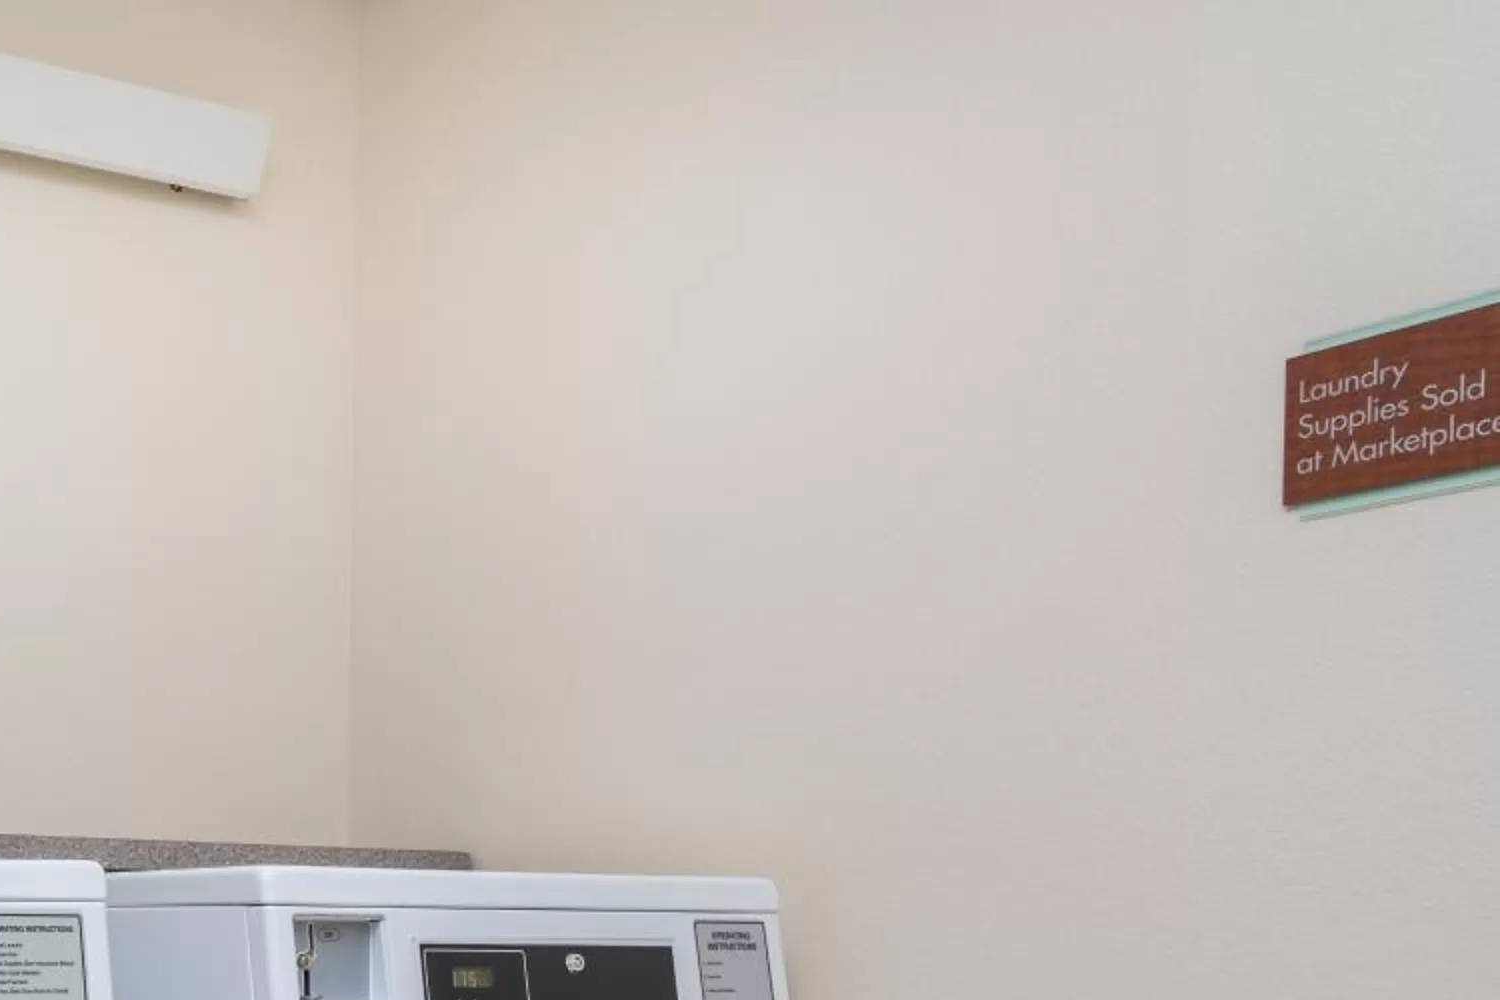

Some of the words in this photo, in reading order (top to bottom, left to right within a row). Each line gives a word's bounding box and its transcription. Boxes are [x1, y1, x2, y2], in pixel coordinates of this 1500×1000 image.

[1297, 395, 1410, 440] Supplies
[1420, 367, 1487, 411] Sold
[1299, 356, 1410, 404] Laundry
[1296, 450, 1324, 475] at
